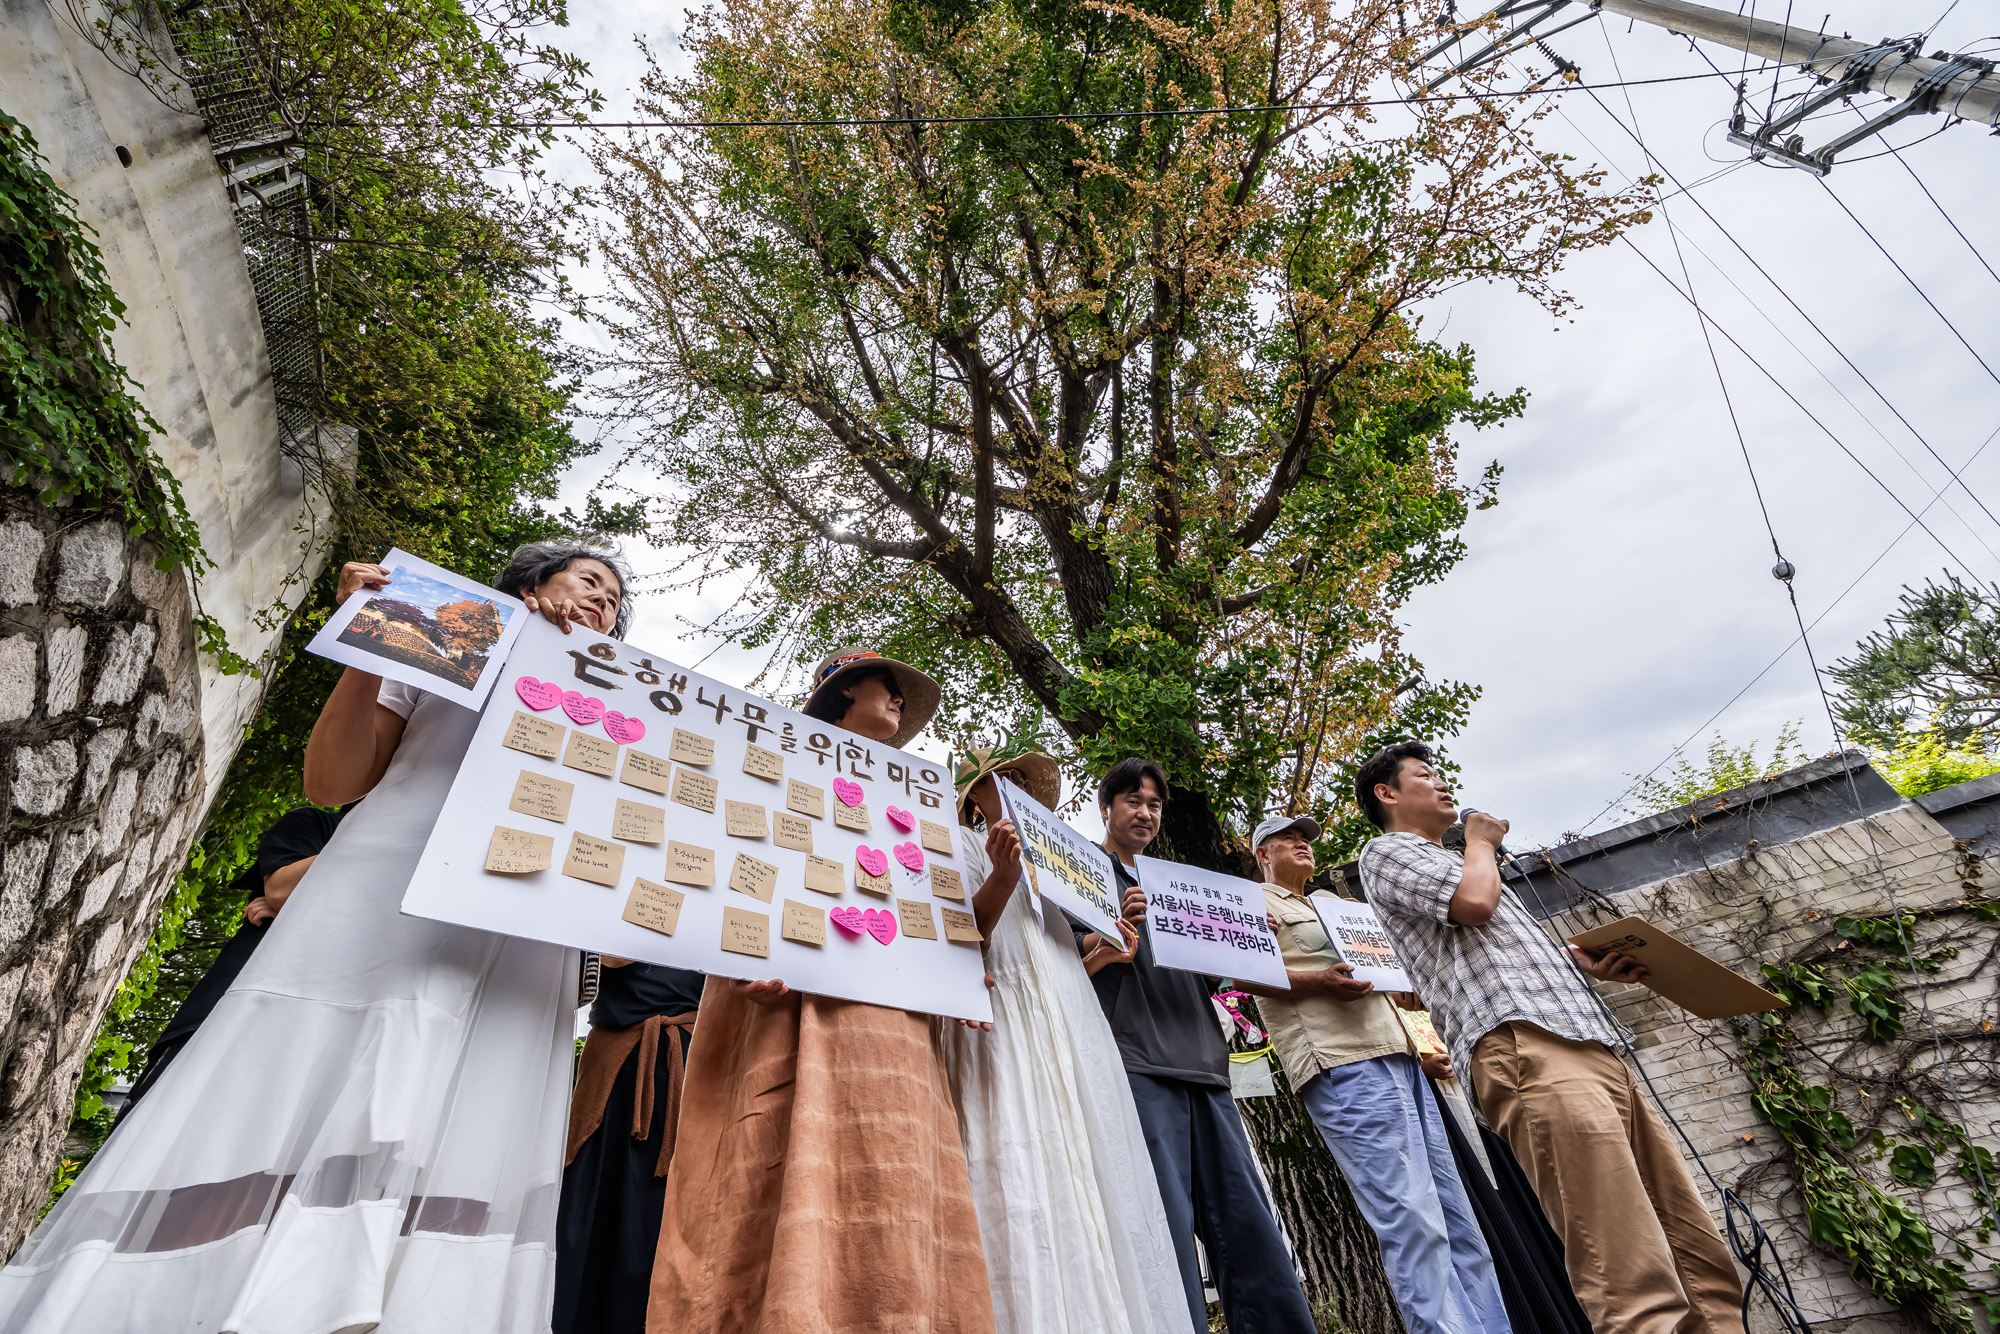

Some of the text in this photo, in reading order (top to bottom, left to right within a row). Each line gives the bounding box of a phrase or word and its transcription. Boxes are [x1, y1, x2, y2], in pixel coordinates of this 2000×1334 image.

[566, 642, 797, 754] 은행나무를
[804, 732, 874, 782] 위한
[887, 761, 943, 808] 마음
[588, 738, 600, 746] love
[502, 830, 534, 850] 황당
[1014, 799, 1110, 876] 생명파괴 미술관 규탄한다
[495, 848, 506, 856] 그
[1022, 817, 1107, 895] 환기미술관은
[1029, 845, 1120, 922] 행나무 살려내라
[1170, 880, 1243, 906] 사유지 핑계 그만
[1150, 893, 1268, 934] 서울시는 은행나무를
[1340, 915, 1379, 928] 은행나무 독살
[1154, 915, 1276, 956] 보호수로 지정하라
[1335, 926, 1390, 949] 환기미술관
[1342, 949, 1382, 968] 책임있게
